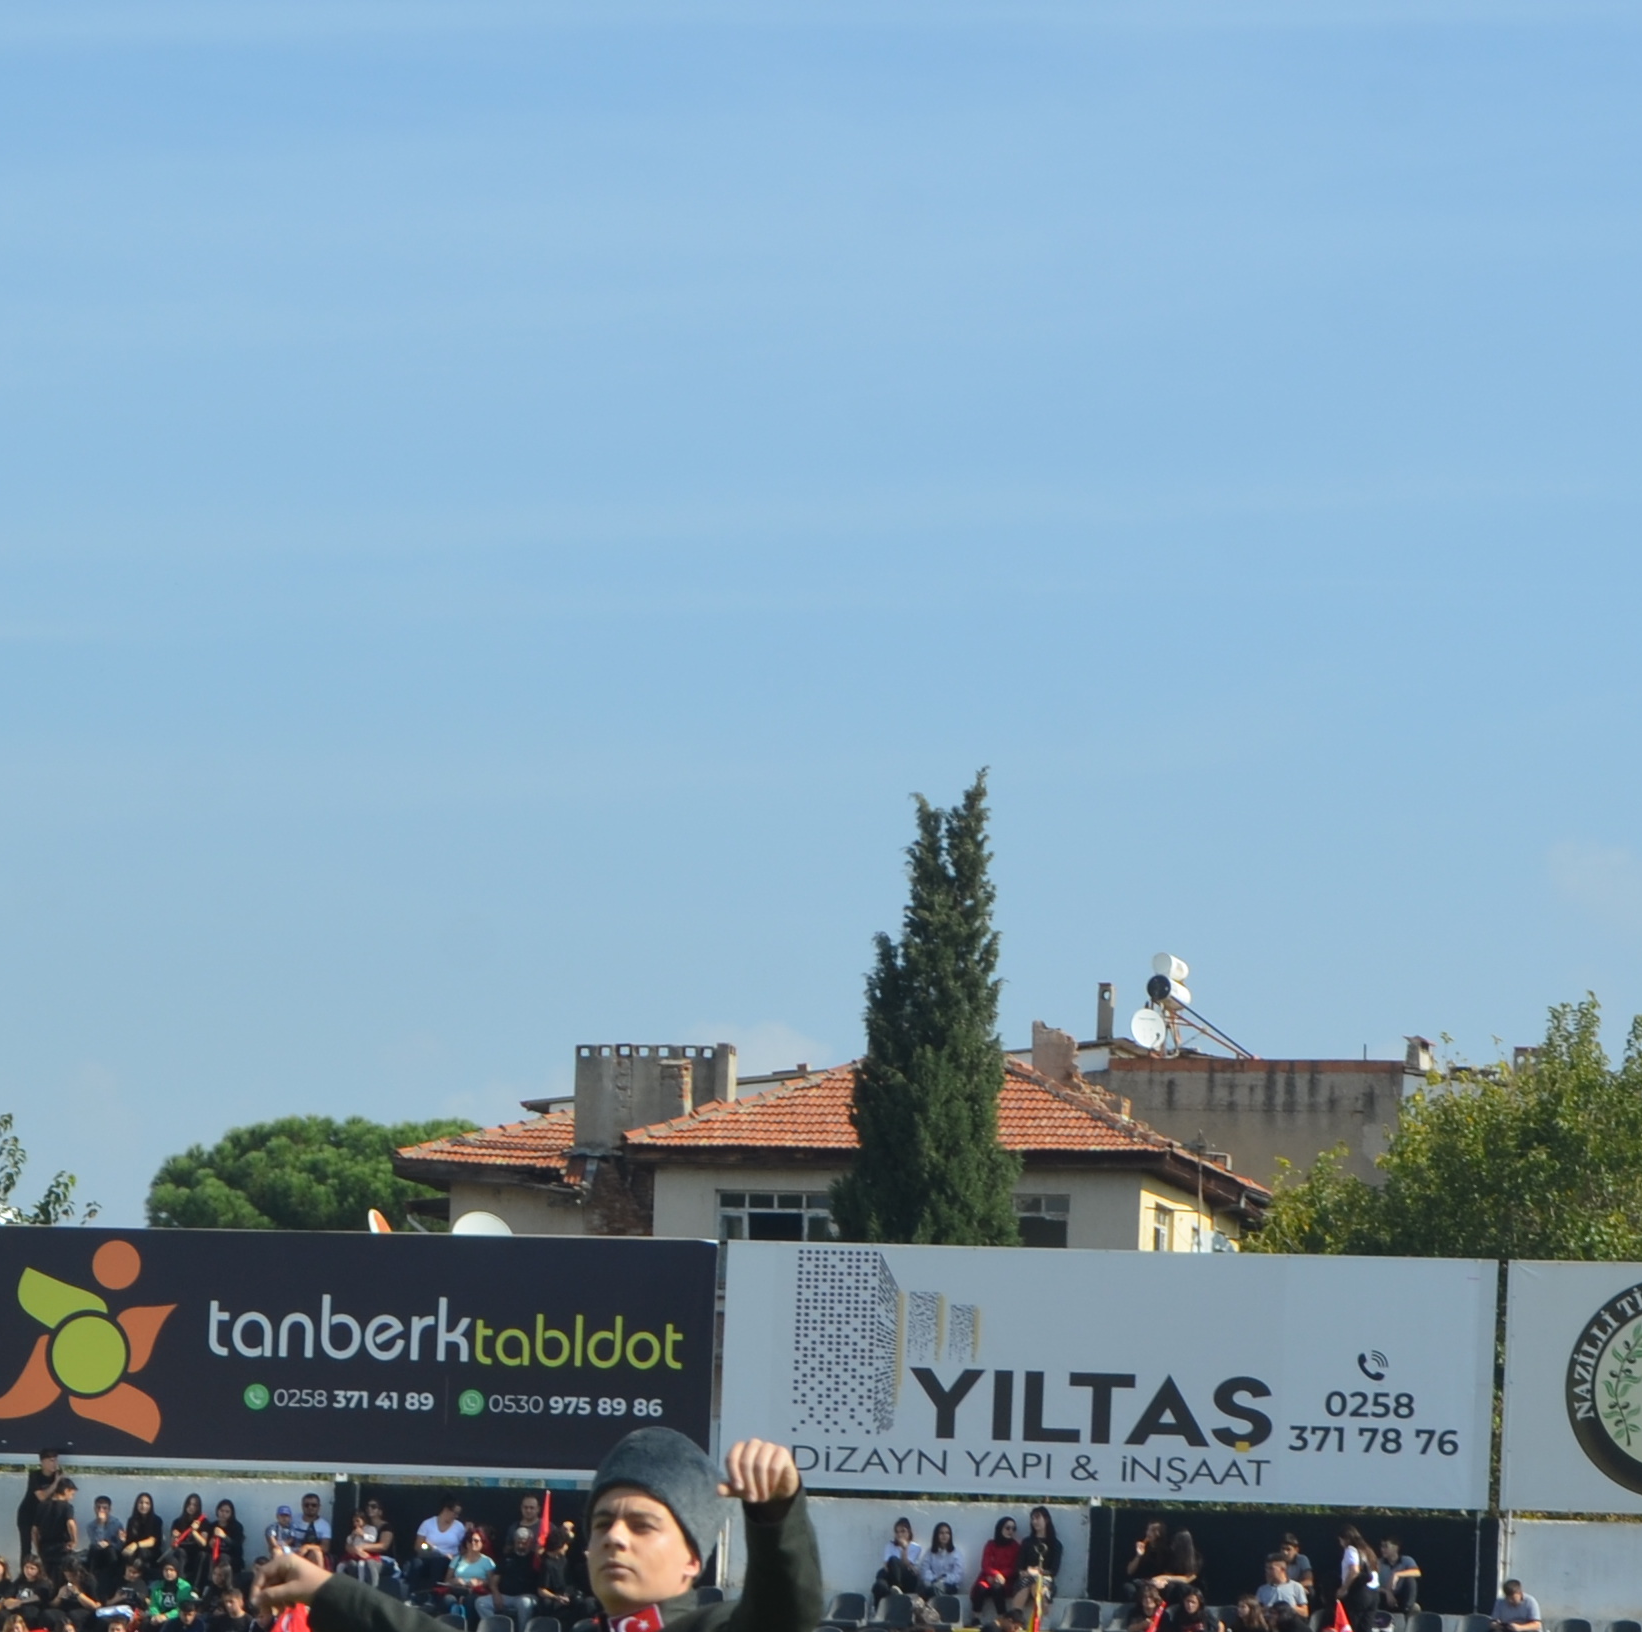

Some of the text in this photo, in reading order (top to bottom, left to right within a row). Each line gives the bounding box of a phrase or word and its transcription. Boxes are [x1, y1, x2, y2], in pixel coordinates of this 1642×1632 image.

[273, 1388, 435, 1411] 0258 371 41 89
[488, 1394, 664, 1417] 0530 975 89 86
[909, 1366, 1274, 1453] YILTAŞ
[1324, 1390, 1415, 1419] 0258
[1288, 1425, 1460, 1456] 371 78 76
[965, 1450, 1053, 1480] YAPI
[1070, 1454, 1100, 1482] &
